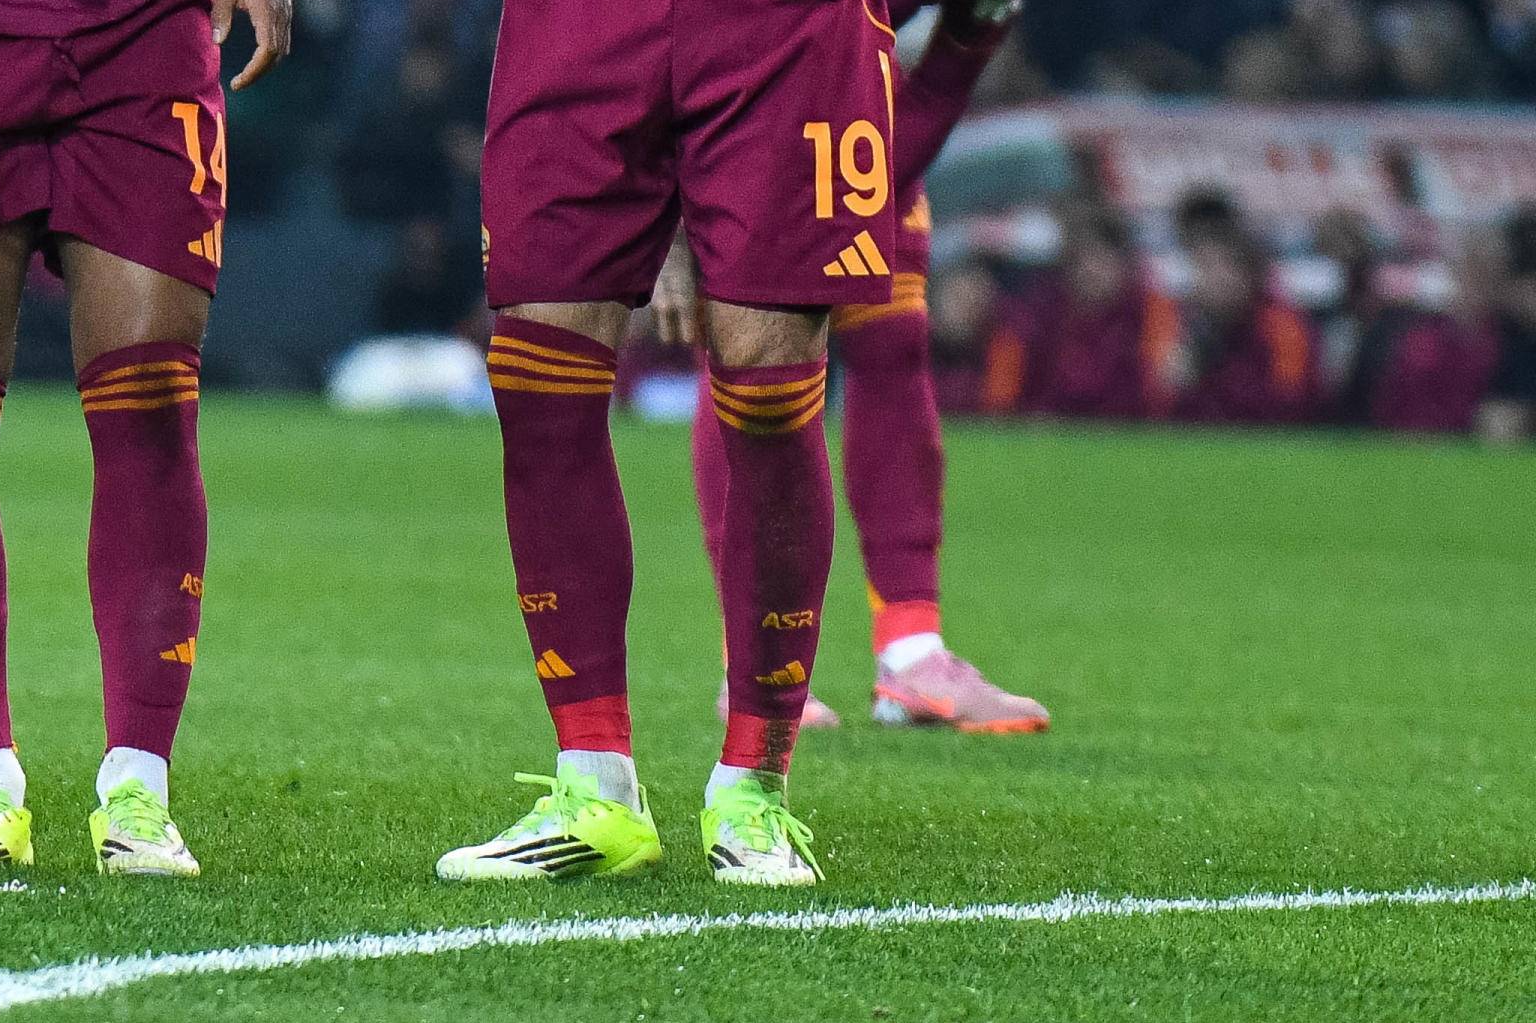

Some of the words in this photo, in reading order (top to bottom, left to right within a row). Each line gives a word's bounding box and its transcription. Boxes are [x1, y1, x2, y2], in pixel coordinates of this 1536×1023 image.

[171, 101, 227, 209] 14
[803, 119, 889, 218] 19
[762, 609, 814, 630] ASR
